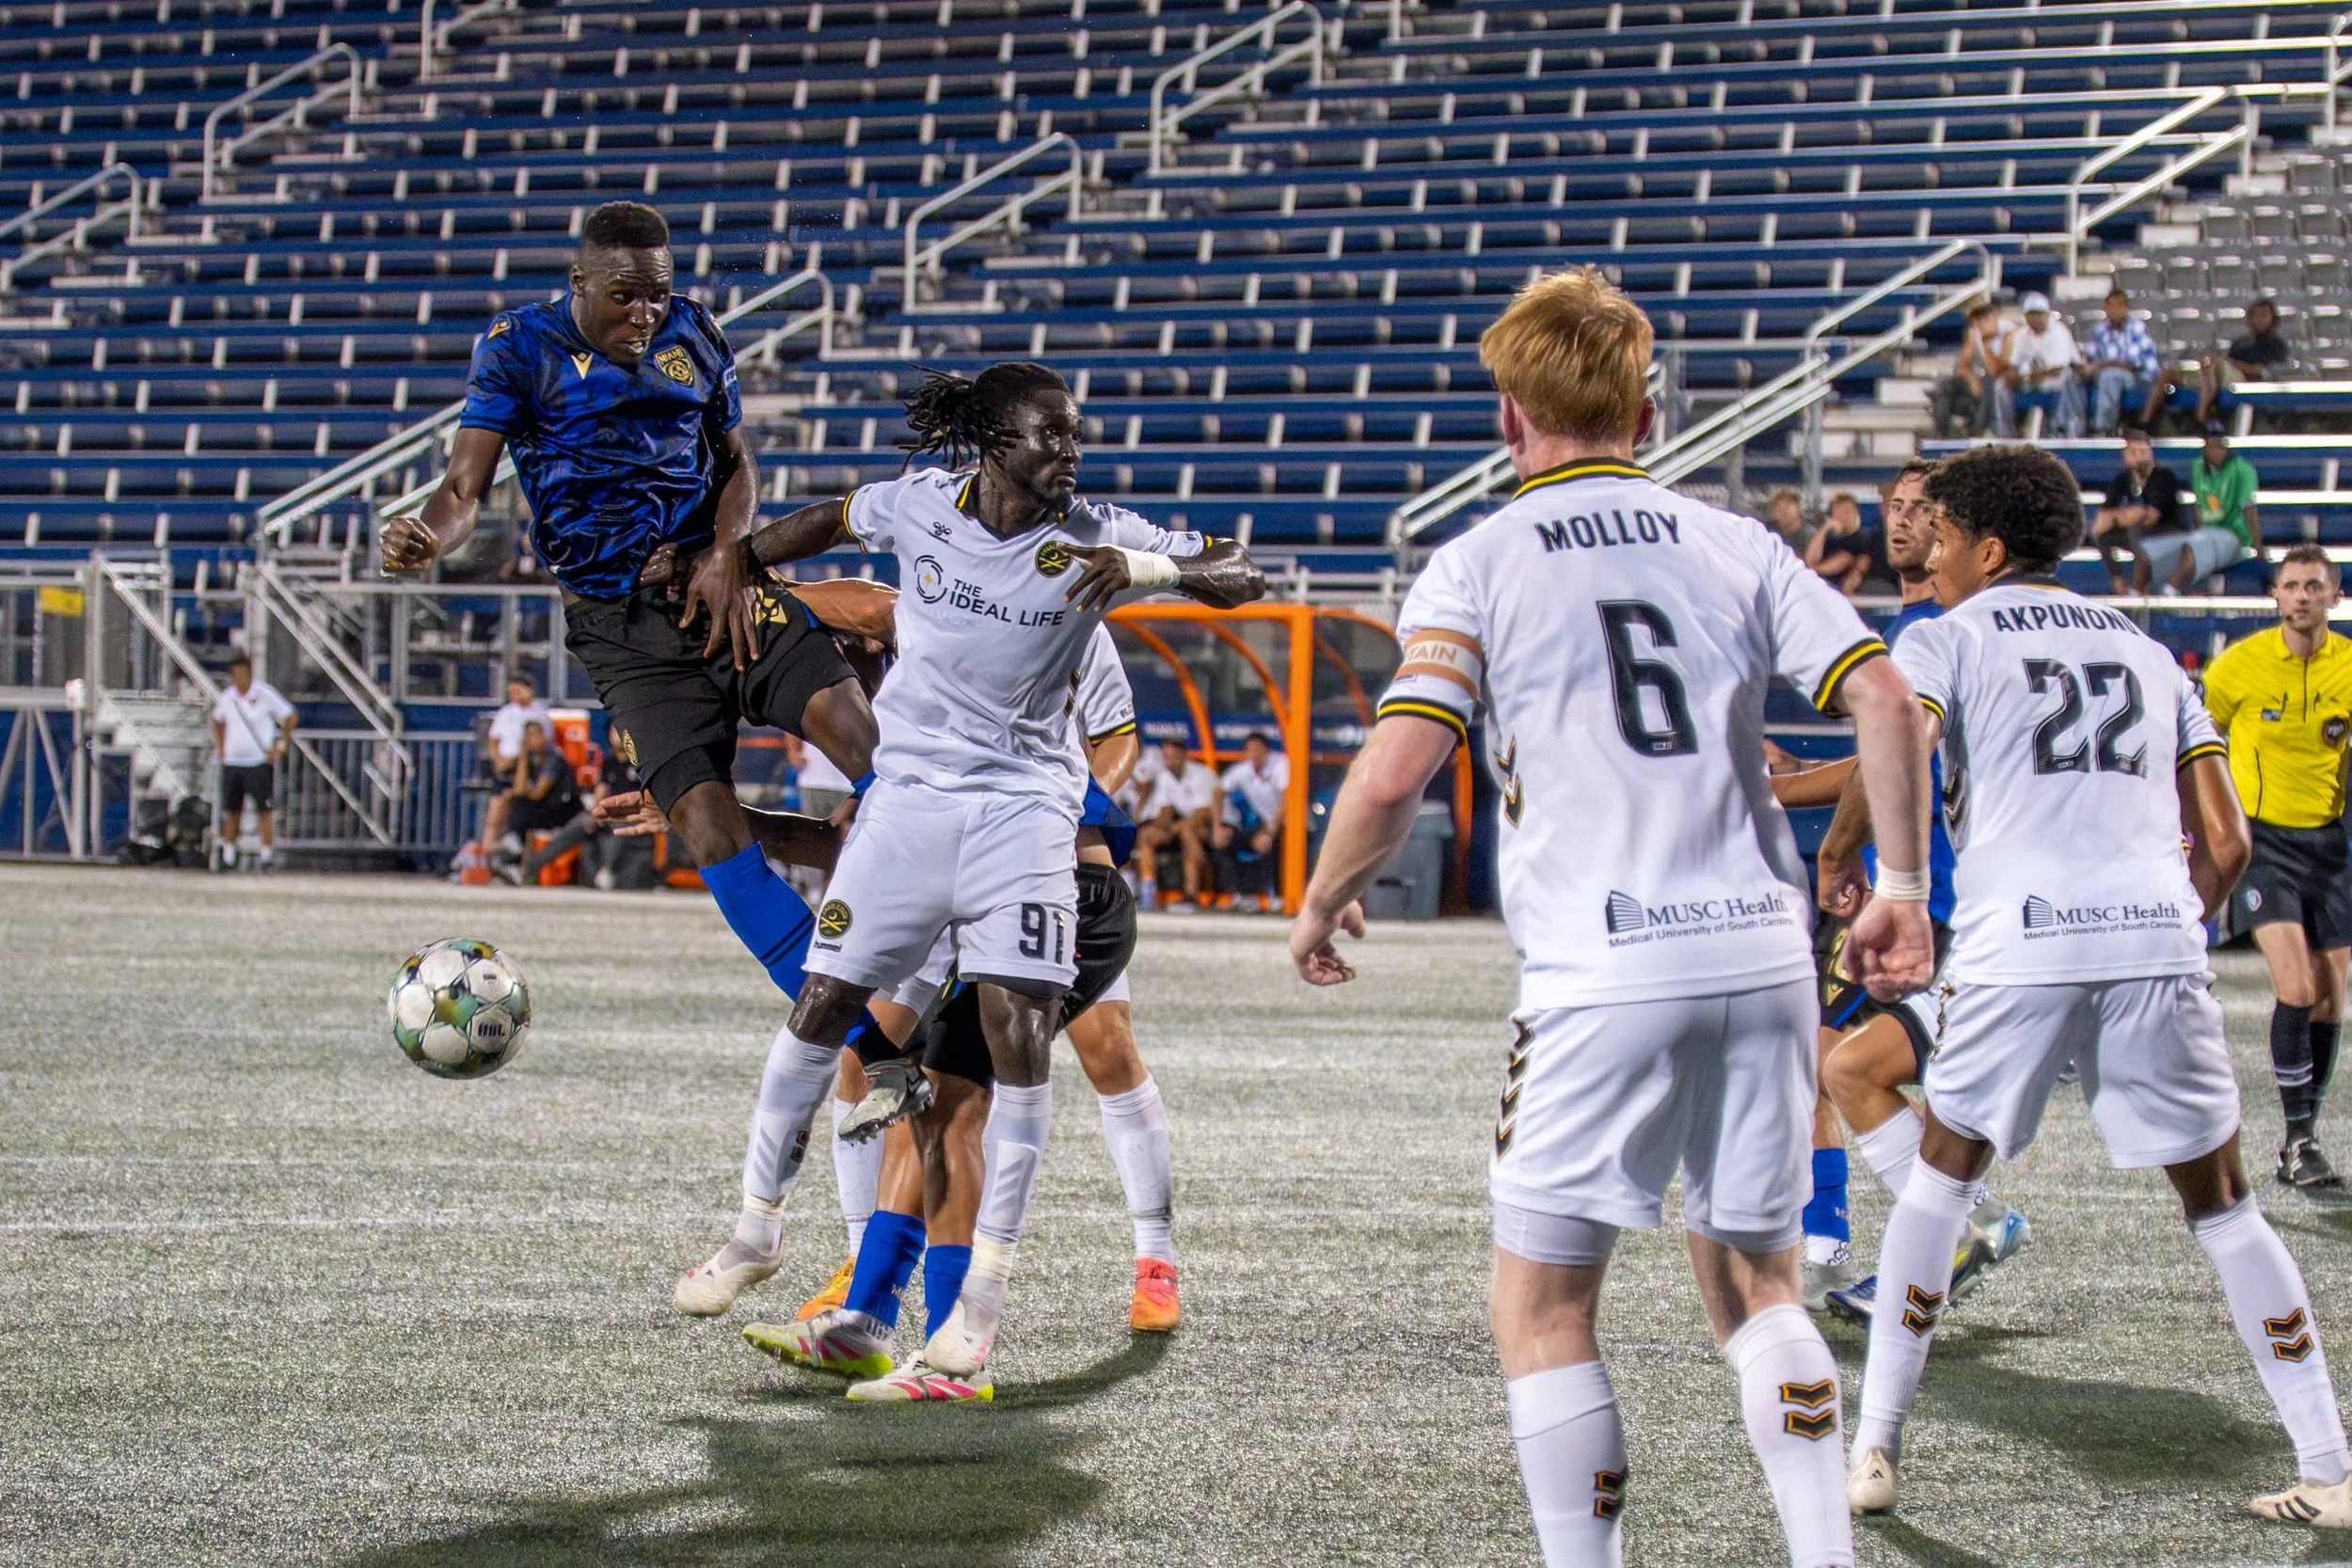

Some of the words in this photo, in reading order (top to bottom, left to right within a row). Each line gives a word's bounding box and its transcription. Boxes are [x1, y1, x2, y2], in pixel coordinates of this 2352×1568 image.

[658, 347, 685, 365] MIAMI
[1534, 509, 1680, 552] MOLLOY
[954, 578, 983, 598] THE
[949, 593, 1012, 623] IDEAL
[1019, 610, 1066, 626] LIFE
[1597, 599, 1699, 758] 6
[2022, 657, 2148, 780] 22
[1647, 900, 1724, 927] MUSC
[1724, 893, 1789, 917] Health
[2055, 906, 2119, 927] MUSC
[2122, 902, 2181, 921] Health
[1018, 902, 1065, 965] 91
[1609, 932, 1654, 948] Medical
[1656, 926, 1712, 941] University
[1714, 923, 1725, 934] of
[1727, 918, 1759, 931] South
[2024, 928, 2059, 941] Medical
[2061, 925, 2108, 936] University
[2109, 923, 2120, 933] of
[2122, 922, 2149, 932] South
[2150, 920, 2183, 930] Carolina
